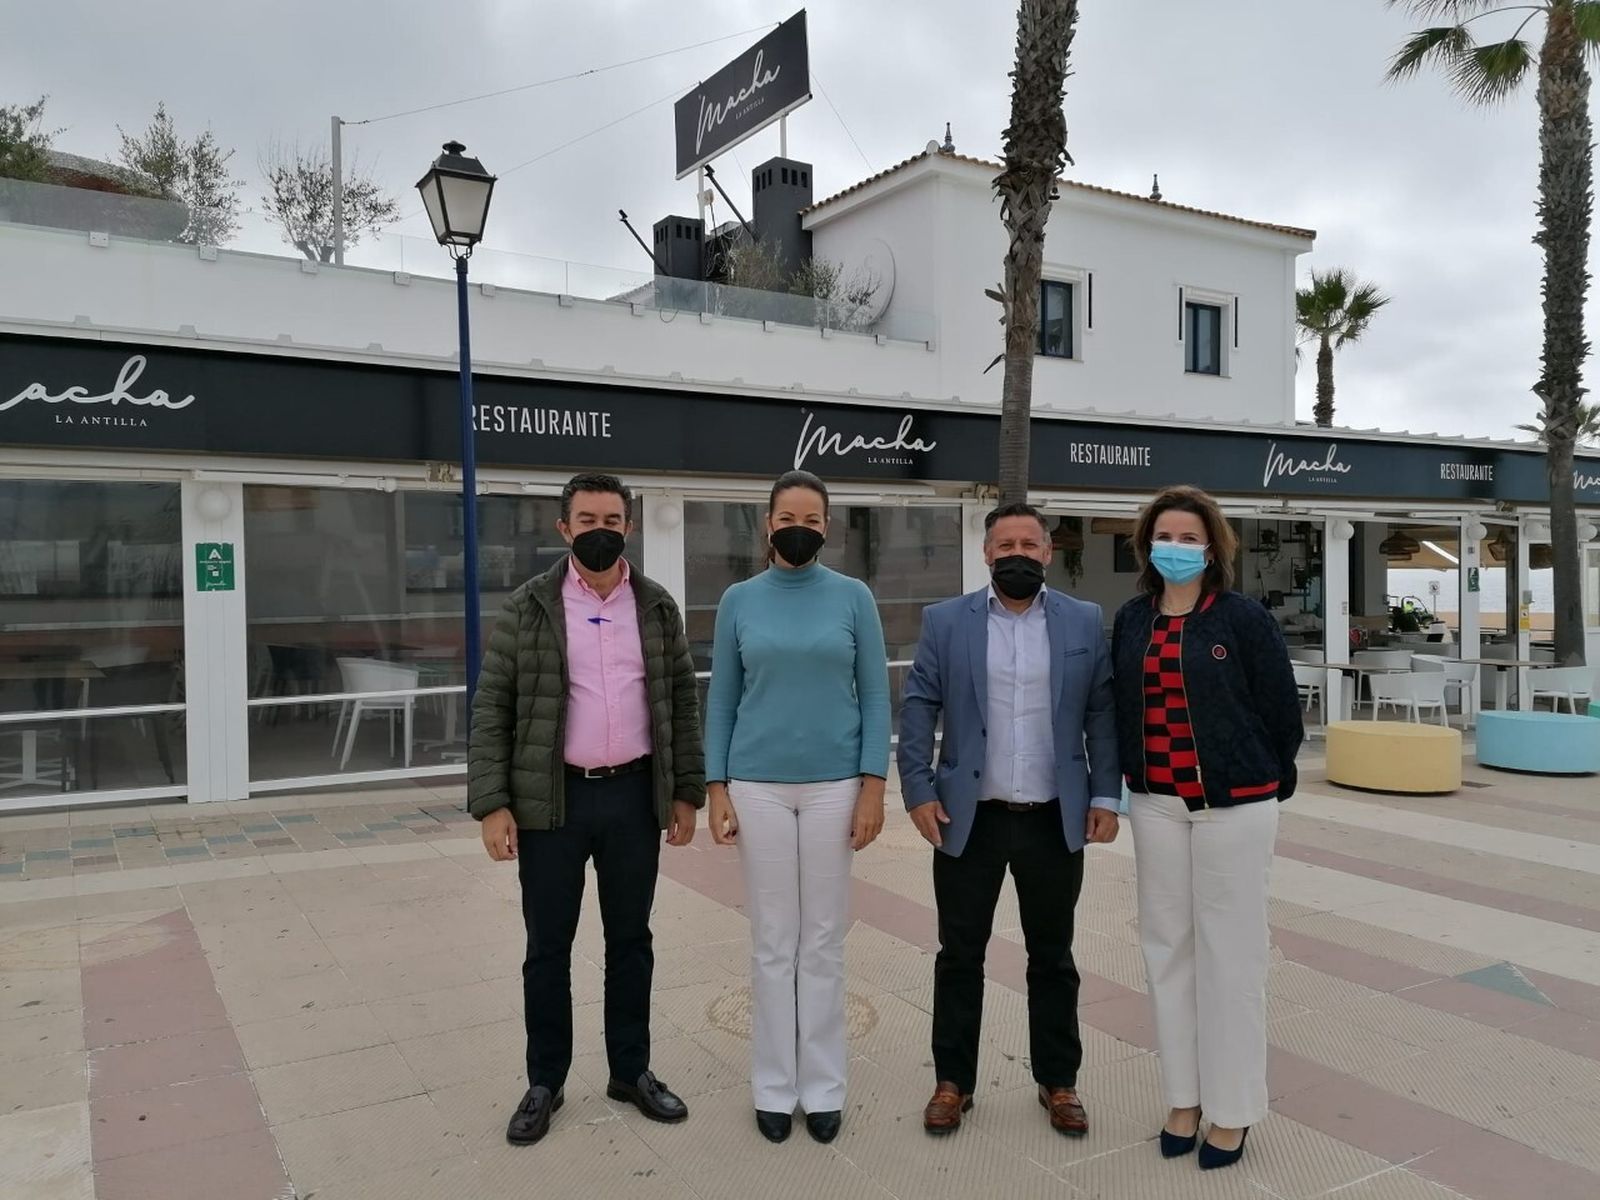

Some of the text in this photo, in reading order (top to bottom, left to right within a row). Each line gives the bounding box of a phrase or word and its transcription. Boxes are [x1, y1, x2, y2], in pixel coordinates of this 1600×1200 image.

[695, 49, 781, 155] Macha
[0, 354, 196, 411] acha
[55, 414, 148, 427] LA ANTILLA
[794, 412, 937, 471] Macha
[1070, 442, 1151, 467] RESTAURANTE
[867, 456, 914, 465] LA ANTILLA
[1263, 443, 1352, 488] Macha
[1440, 463, 1494, 481] RESTAURANTE
